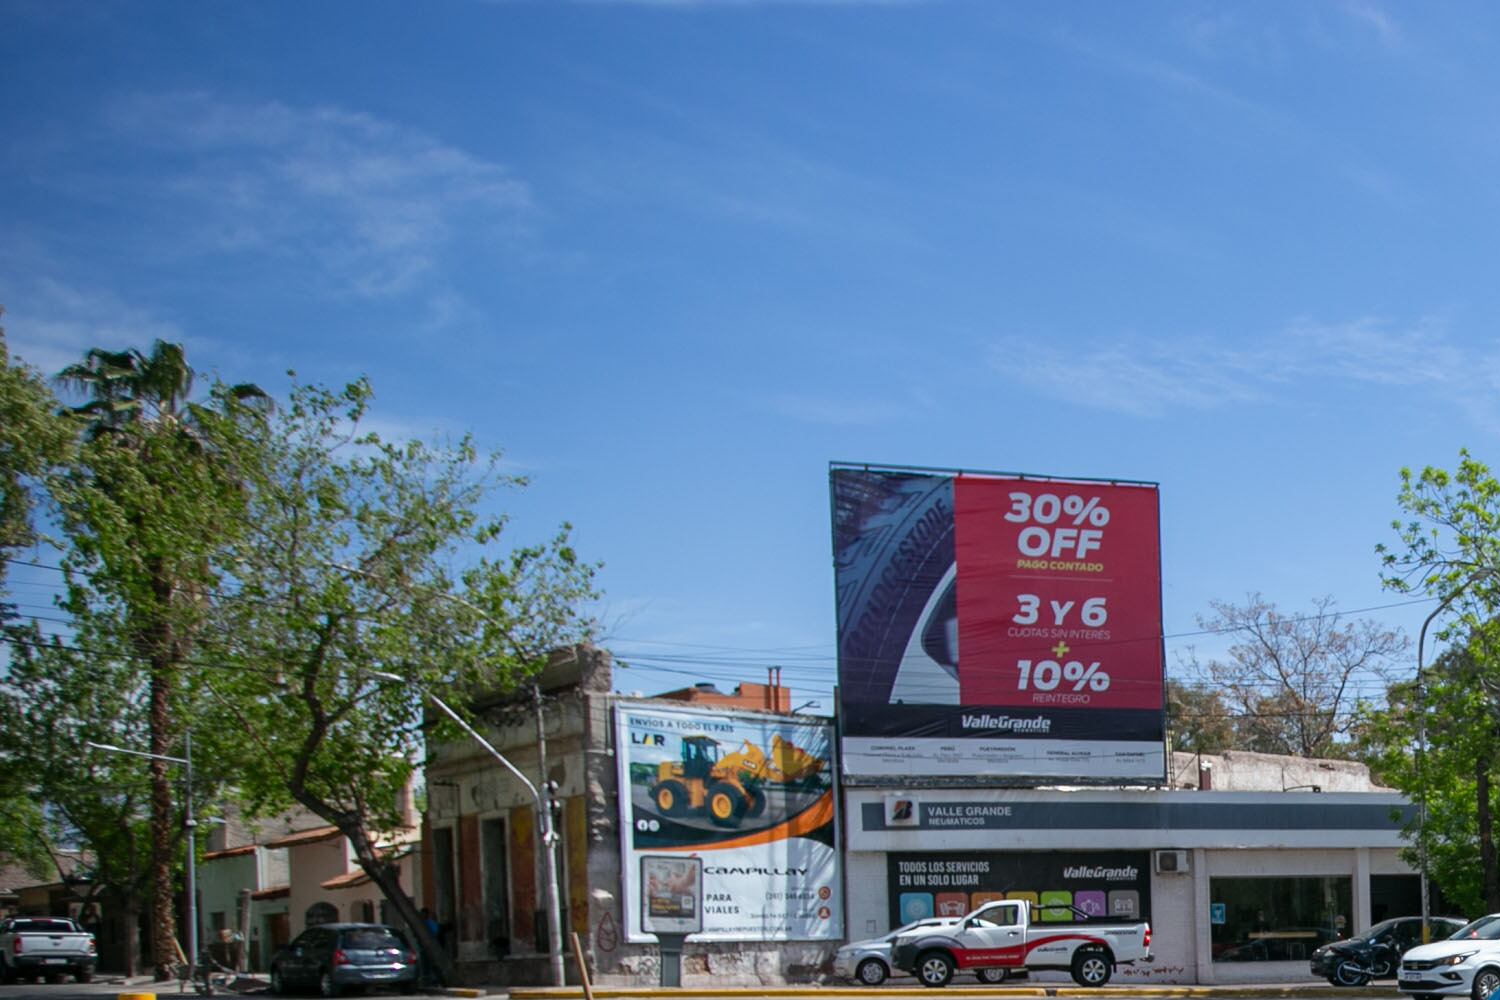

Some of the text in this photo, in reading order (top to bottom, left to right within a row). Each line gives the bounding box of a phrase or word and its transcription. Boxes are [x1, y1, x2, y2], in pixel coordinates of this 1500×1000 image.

[1004, 492, 1110, 527] 30%
[1017, 526, 1103, 560] OFF
[1017, 559, 1104, 572] PAGO CONTADO
[1012, 594, 1108, 627] 3 Y 6
[1008, 627, 1048, 638] CUOTAS
[1050, 628, 1067, 639] SIN
[1016, 659, 1110, 692] 10%
[1032, 693, 1091, 704] REINTEGRO
[676, 721, 701, 730] TODO
[962, 714, 1051, 729] ValleGrande
[928, 806, 1012, 816] VALLE GRANDE
[899, 861, 990, 873] TODOS LOS SERVICIOS
[1063, 865, 1138, 878] ValleGrande
[899, 875, 979, 886] EN UN SOLO LUGAR
[706, 893, 732, 902] PARA
[704, 905, 740, 914] VIALES
